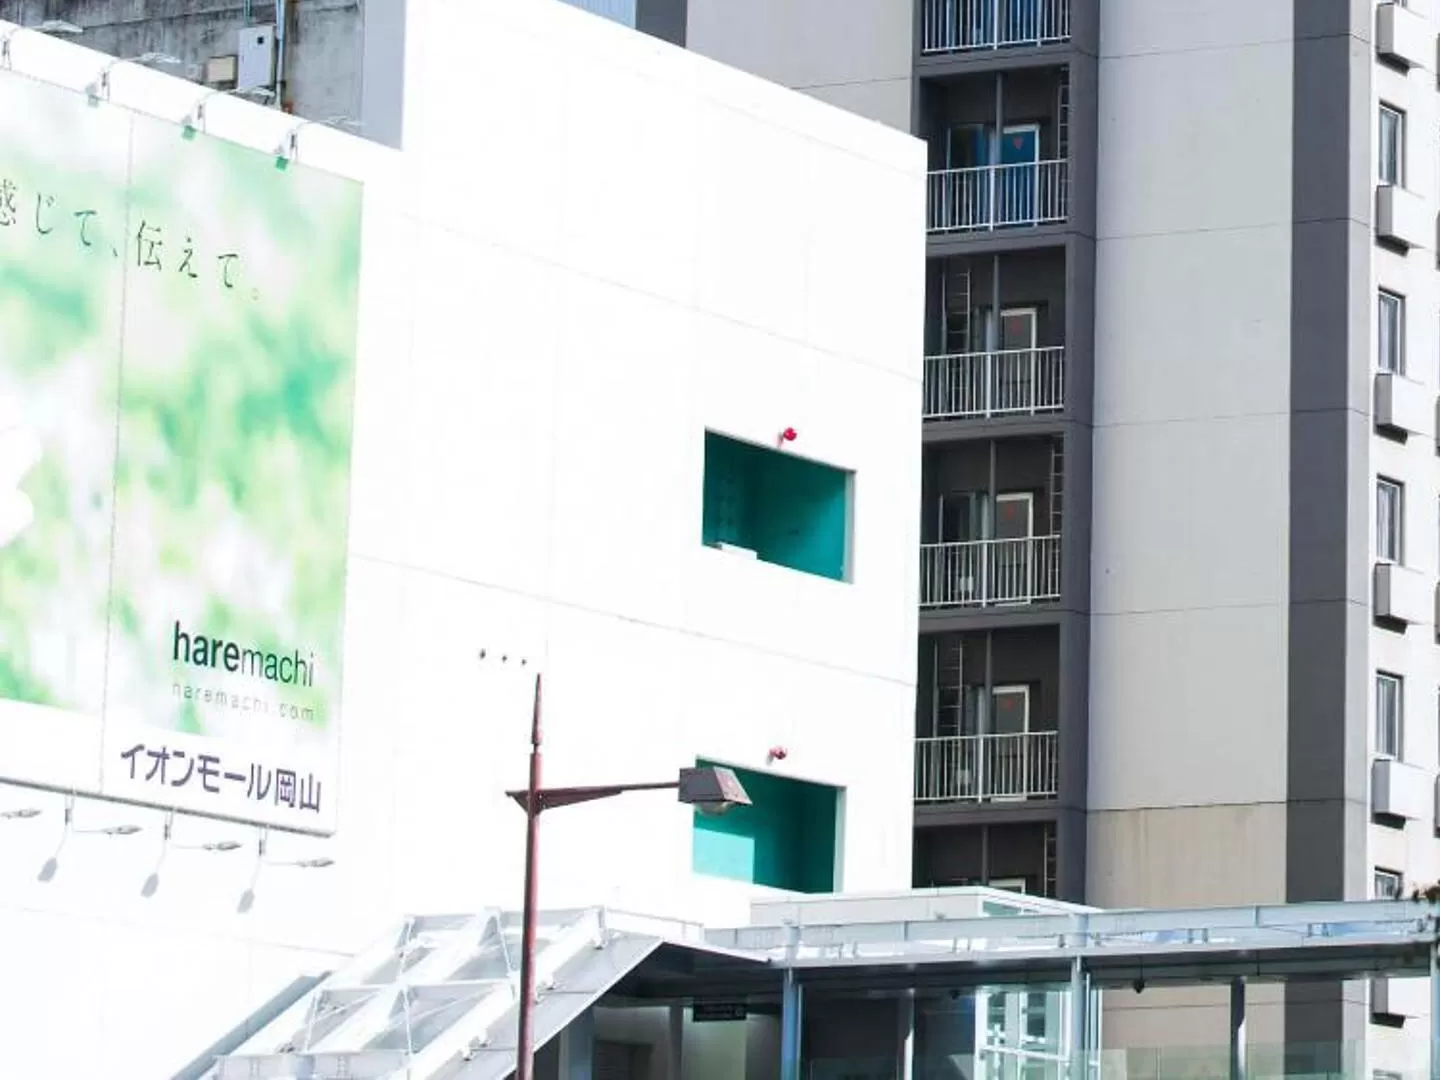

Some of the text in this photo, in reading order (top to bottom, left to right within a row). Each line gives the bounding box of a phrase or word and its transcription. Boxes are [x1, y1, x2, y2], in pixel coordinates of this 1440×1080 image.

[173, 620, 315, 687] haremachi
[120, 743, 322, 813] イオンモール岡山
